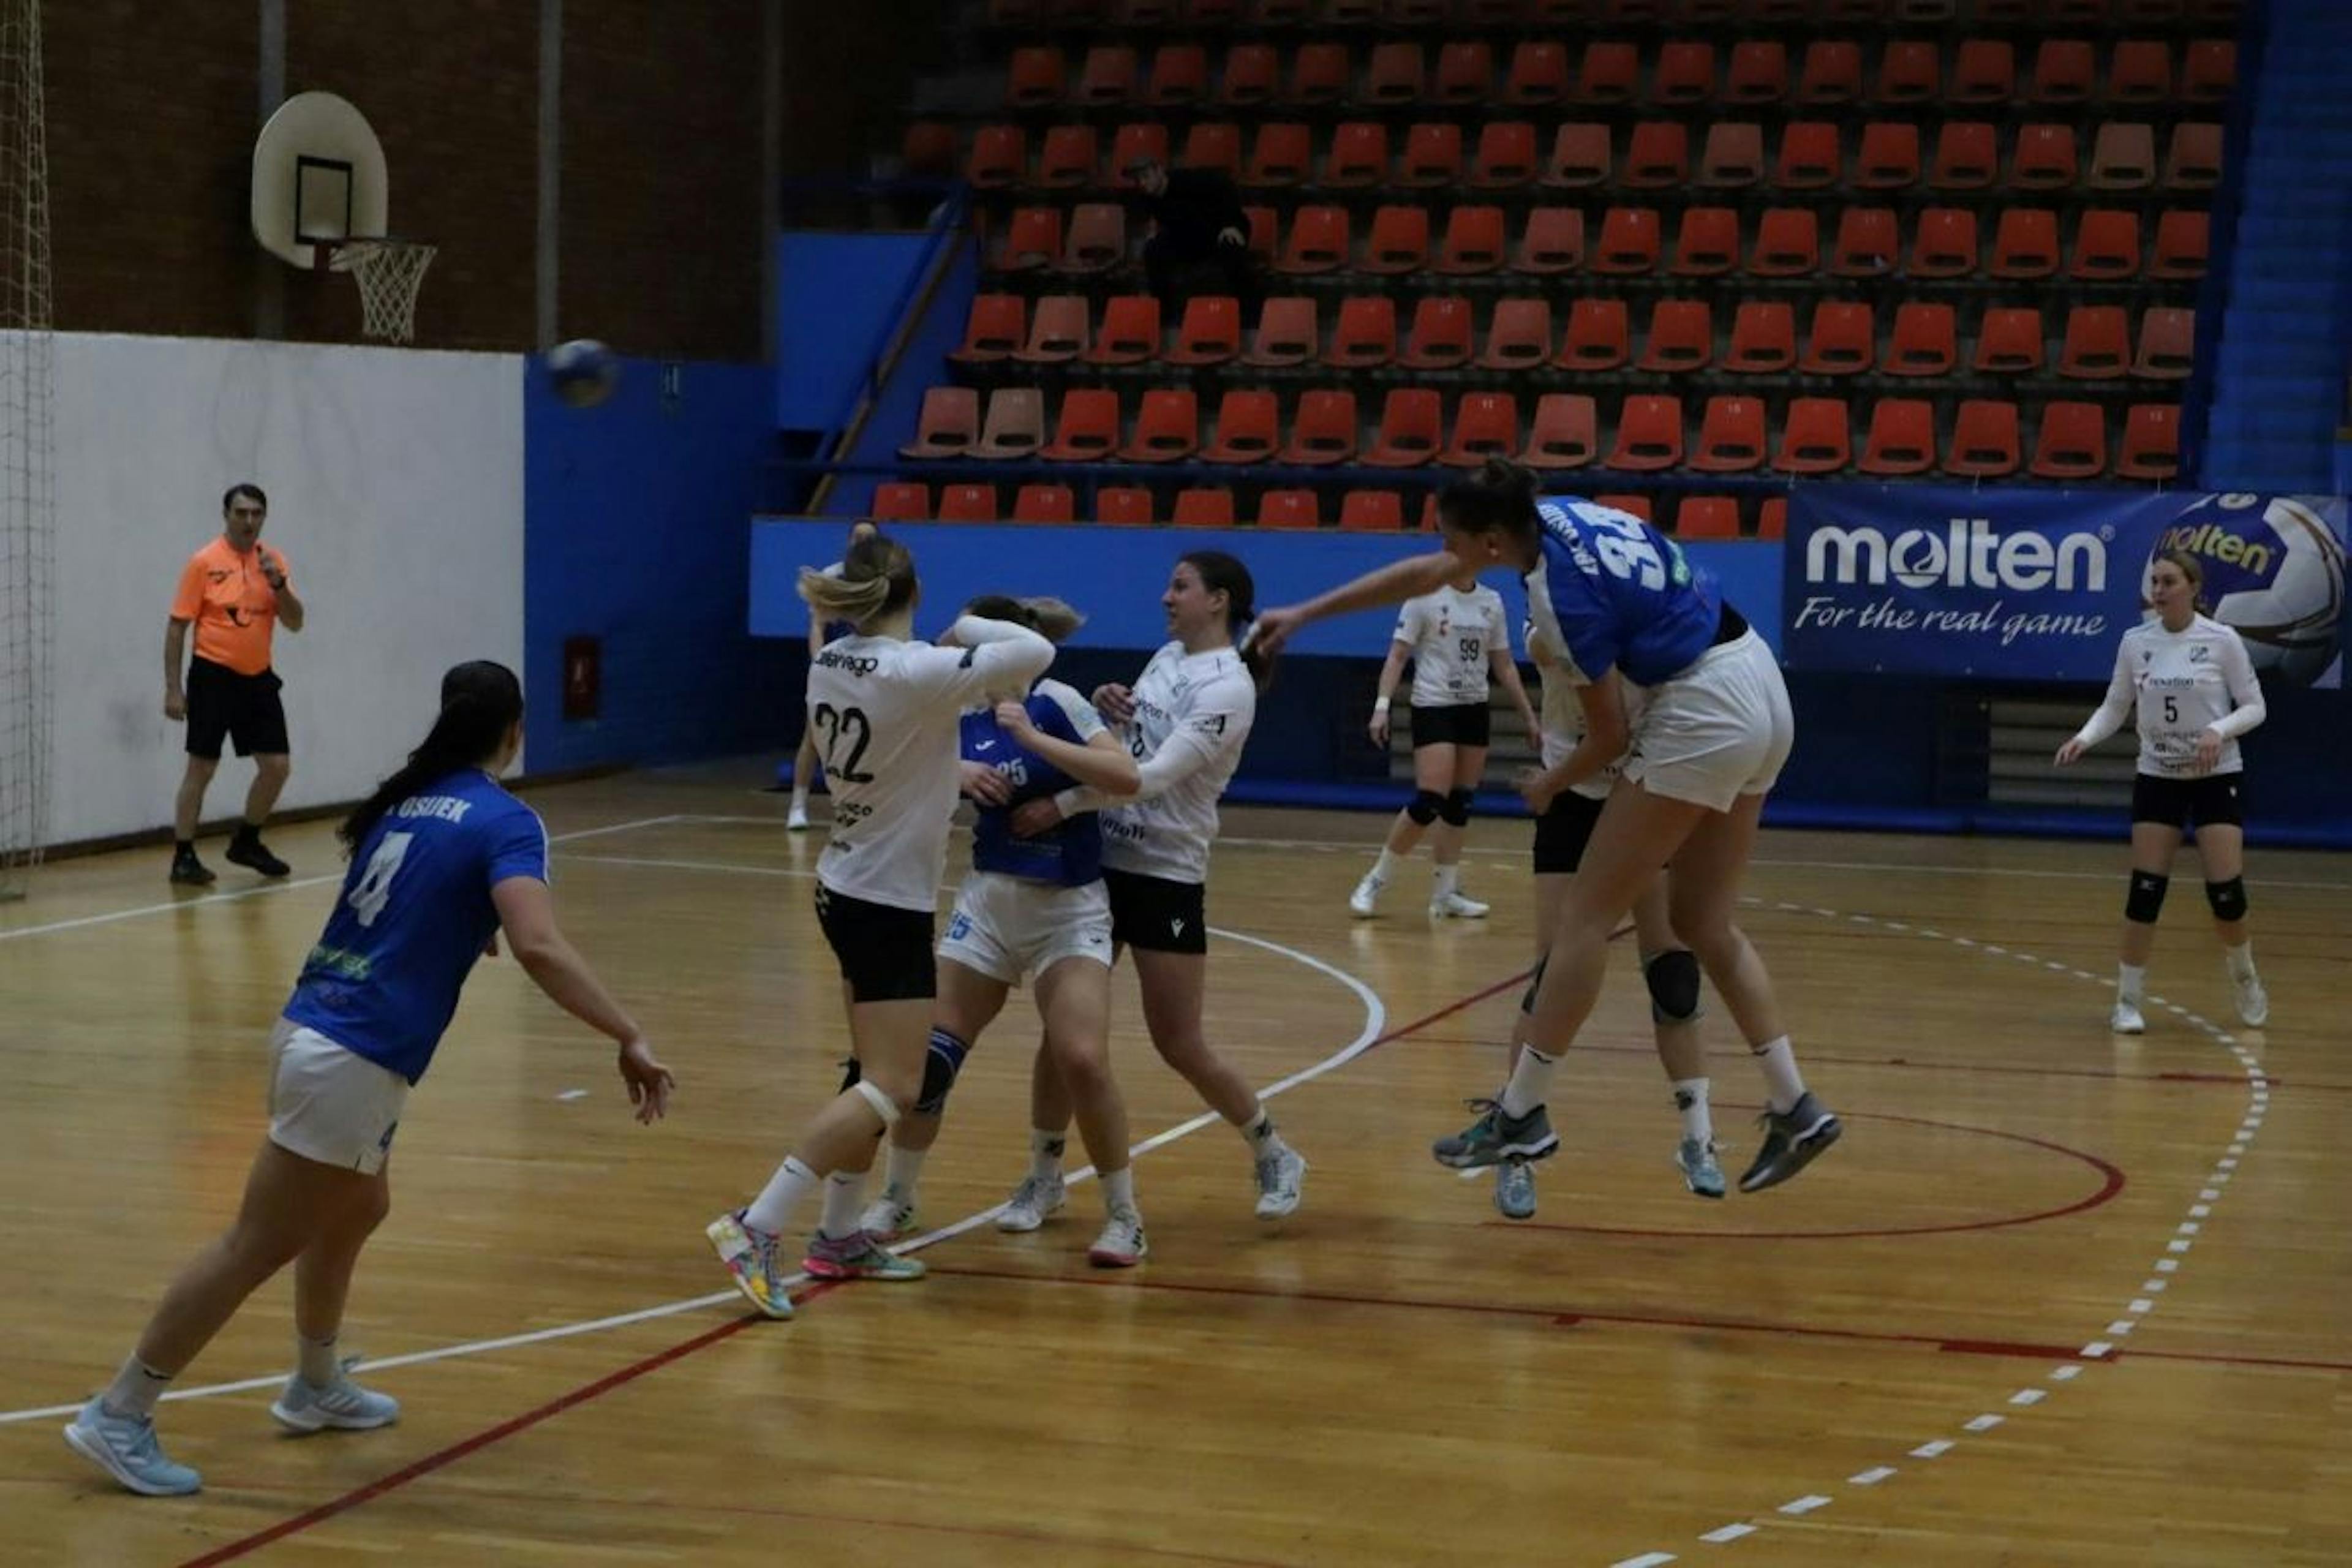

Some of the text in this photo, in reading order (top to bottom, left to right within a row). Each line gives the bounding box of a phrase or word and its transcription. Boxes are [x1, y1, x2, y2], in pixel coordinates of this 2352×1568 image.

[1806, 519, 2106, 591] molten
[1460, 638, 1480, 662] 99
[1795, 596, 2108, 647] For the real game
[2165, 696, 2178, 723] 5
[816, 703, 874, 783] 22
[349, 831, 415, 927] 4
